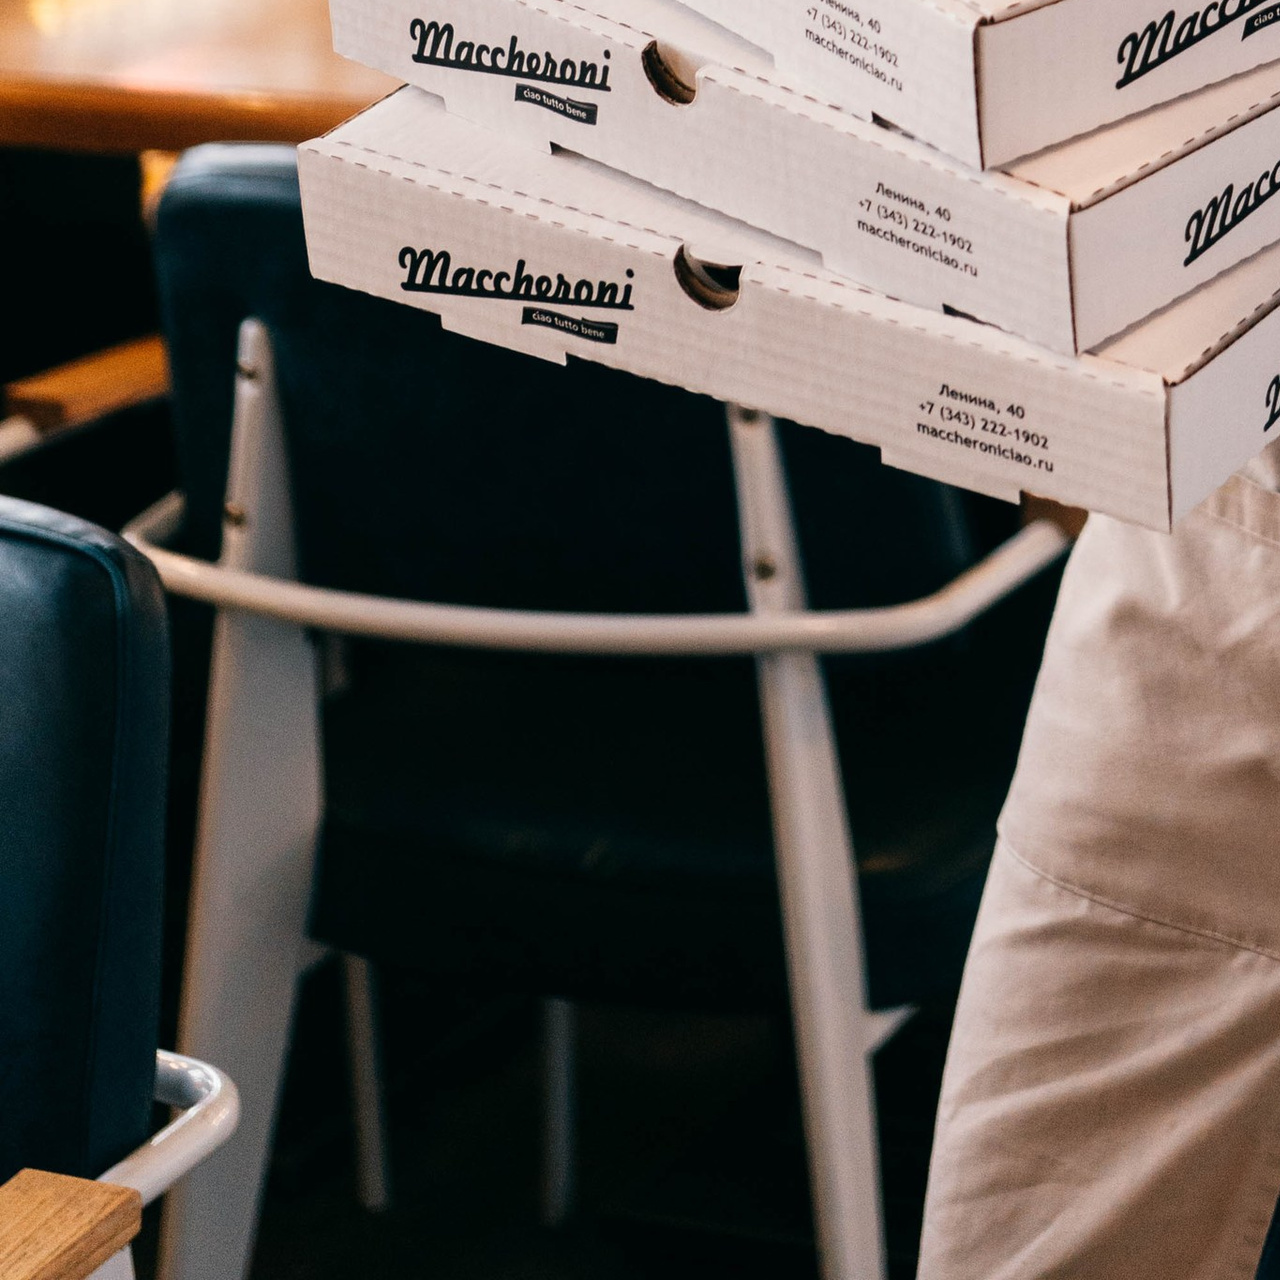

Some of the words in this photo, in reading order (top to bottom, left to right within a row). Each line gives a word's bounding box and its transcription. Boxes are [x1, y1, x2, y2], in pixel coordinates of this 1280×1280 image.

[806, 7, 818, 21] +7
[821, 14, 847, 40] (343)
[849, 29, 899, 68] 222-1902
[867, 18, 881, 34] 40
[1253, 13, 1274, 27] ciao
[410, 18, 611, 92] Maccheroni
[805, 28, 902, 91] maccheroniciao.ru
[523, 87, 541, 101] ciao
[542, 94, 564, 111] tutto
[565, 103, 587, 119] bene
[859, 198, 872, 212] +7
[877, 204, 908, 230] (343)
[912, 219, 973, 254] 222-1902
[875, 182, 930, 216] Ленина,
[935, 206, 951, 222] 40
[857, 220, 978, 277] maccheroniciao.ru
[398, 246, 634, 310] Maccheroni
[532, 310, 552, 324] ciao
[554, 316, 579, 332] tutto
[581, 323, 605, 339] bene
[918, 401, 935, 415] +7
[940, 405, 975, 430] (343)
[980, 417, 1049, 450] 222-1902
[938, 384, 1001, 415] Ленина,
[1006, 403, 1025, 419] 40
[916, 422, 1054, 473] maccheroniciao.ru
